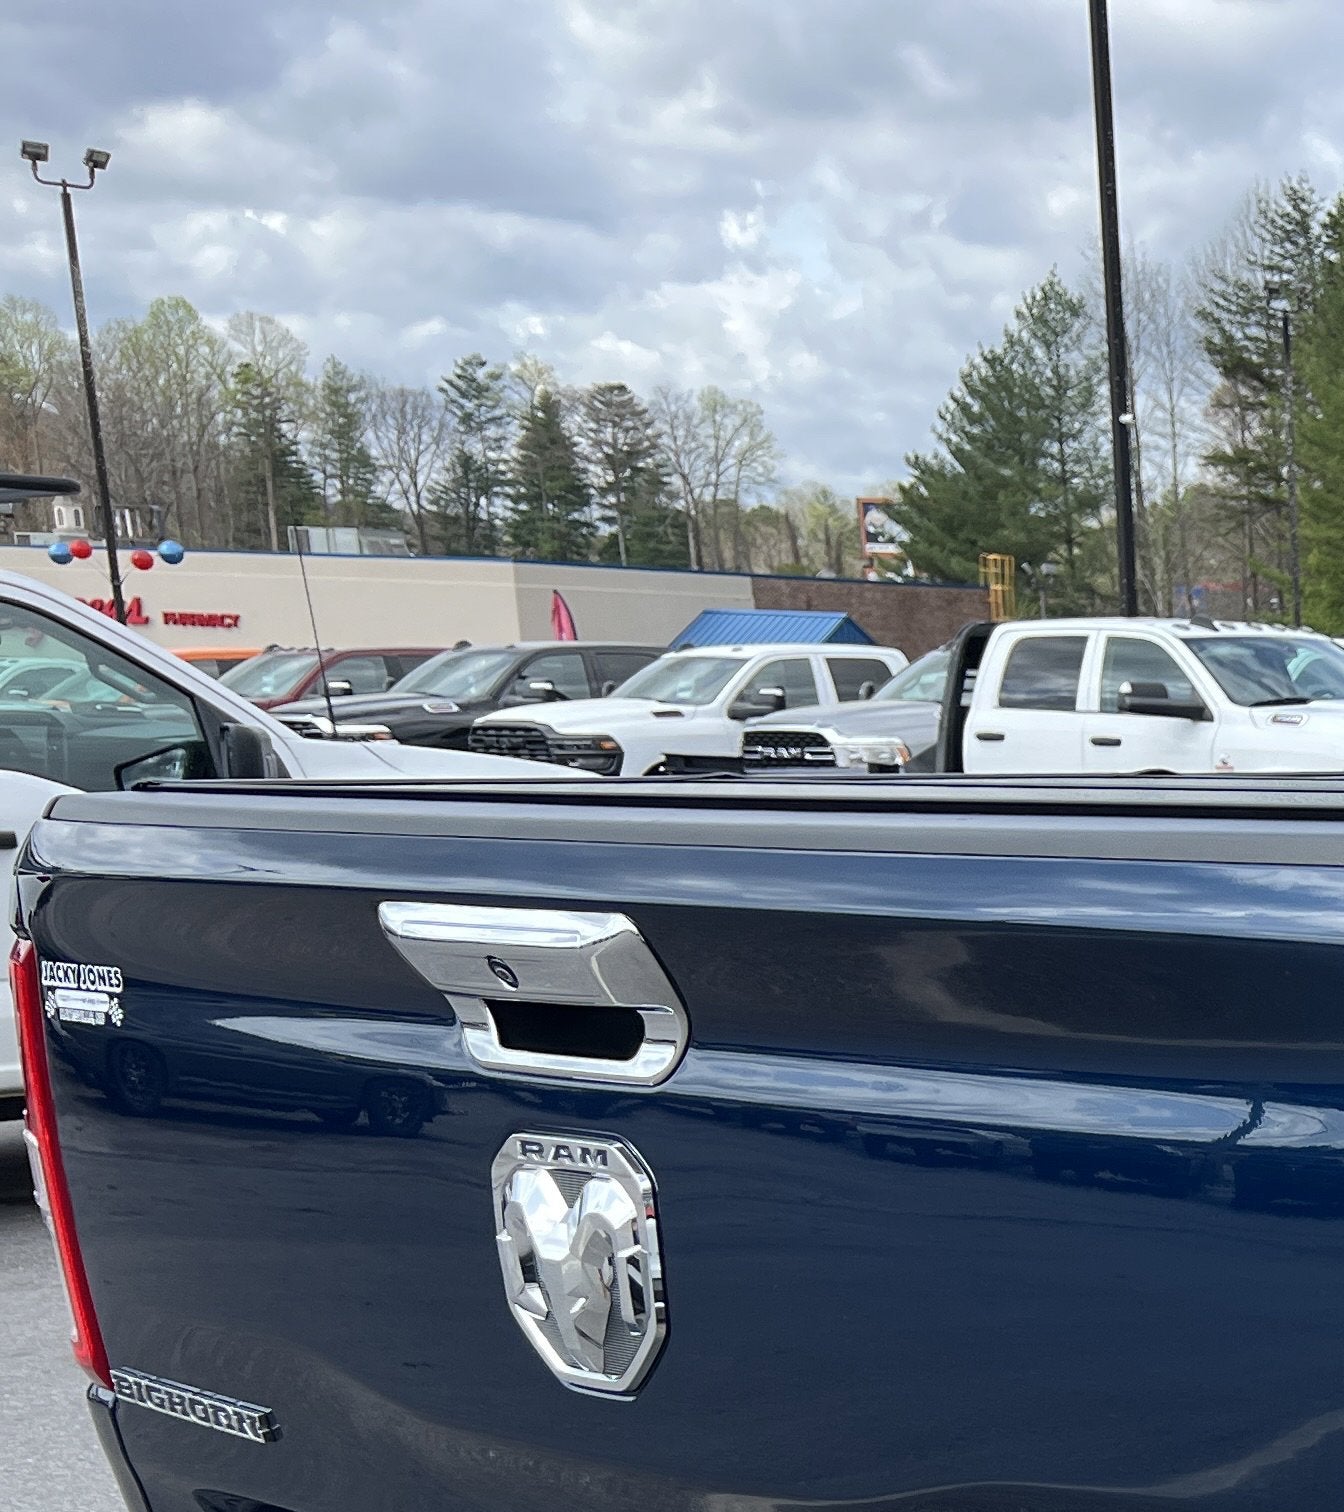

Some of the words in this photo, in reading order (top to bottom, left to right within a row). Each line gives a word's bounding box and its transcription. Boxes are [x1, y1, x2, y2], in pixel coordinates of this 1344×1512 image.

[43, 962, 78, 986] JACKY
[80, 965, 122, 991] JONES
[519, 1139, 610, 1167] RAM
[112, 1370, 266, 1443] BIGHORN
